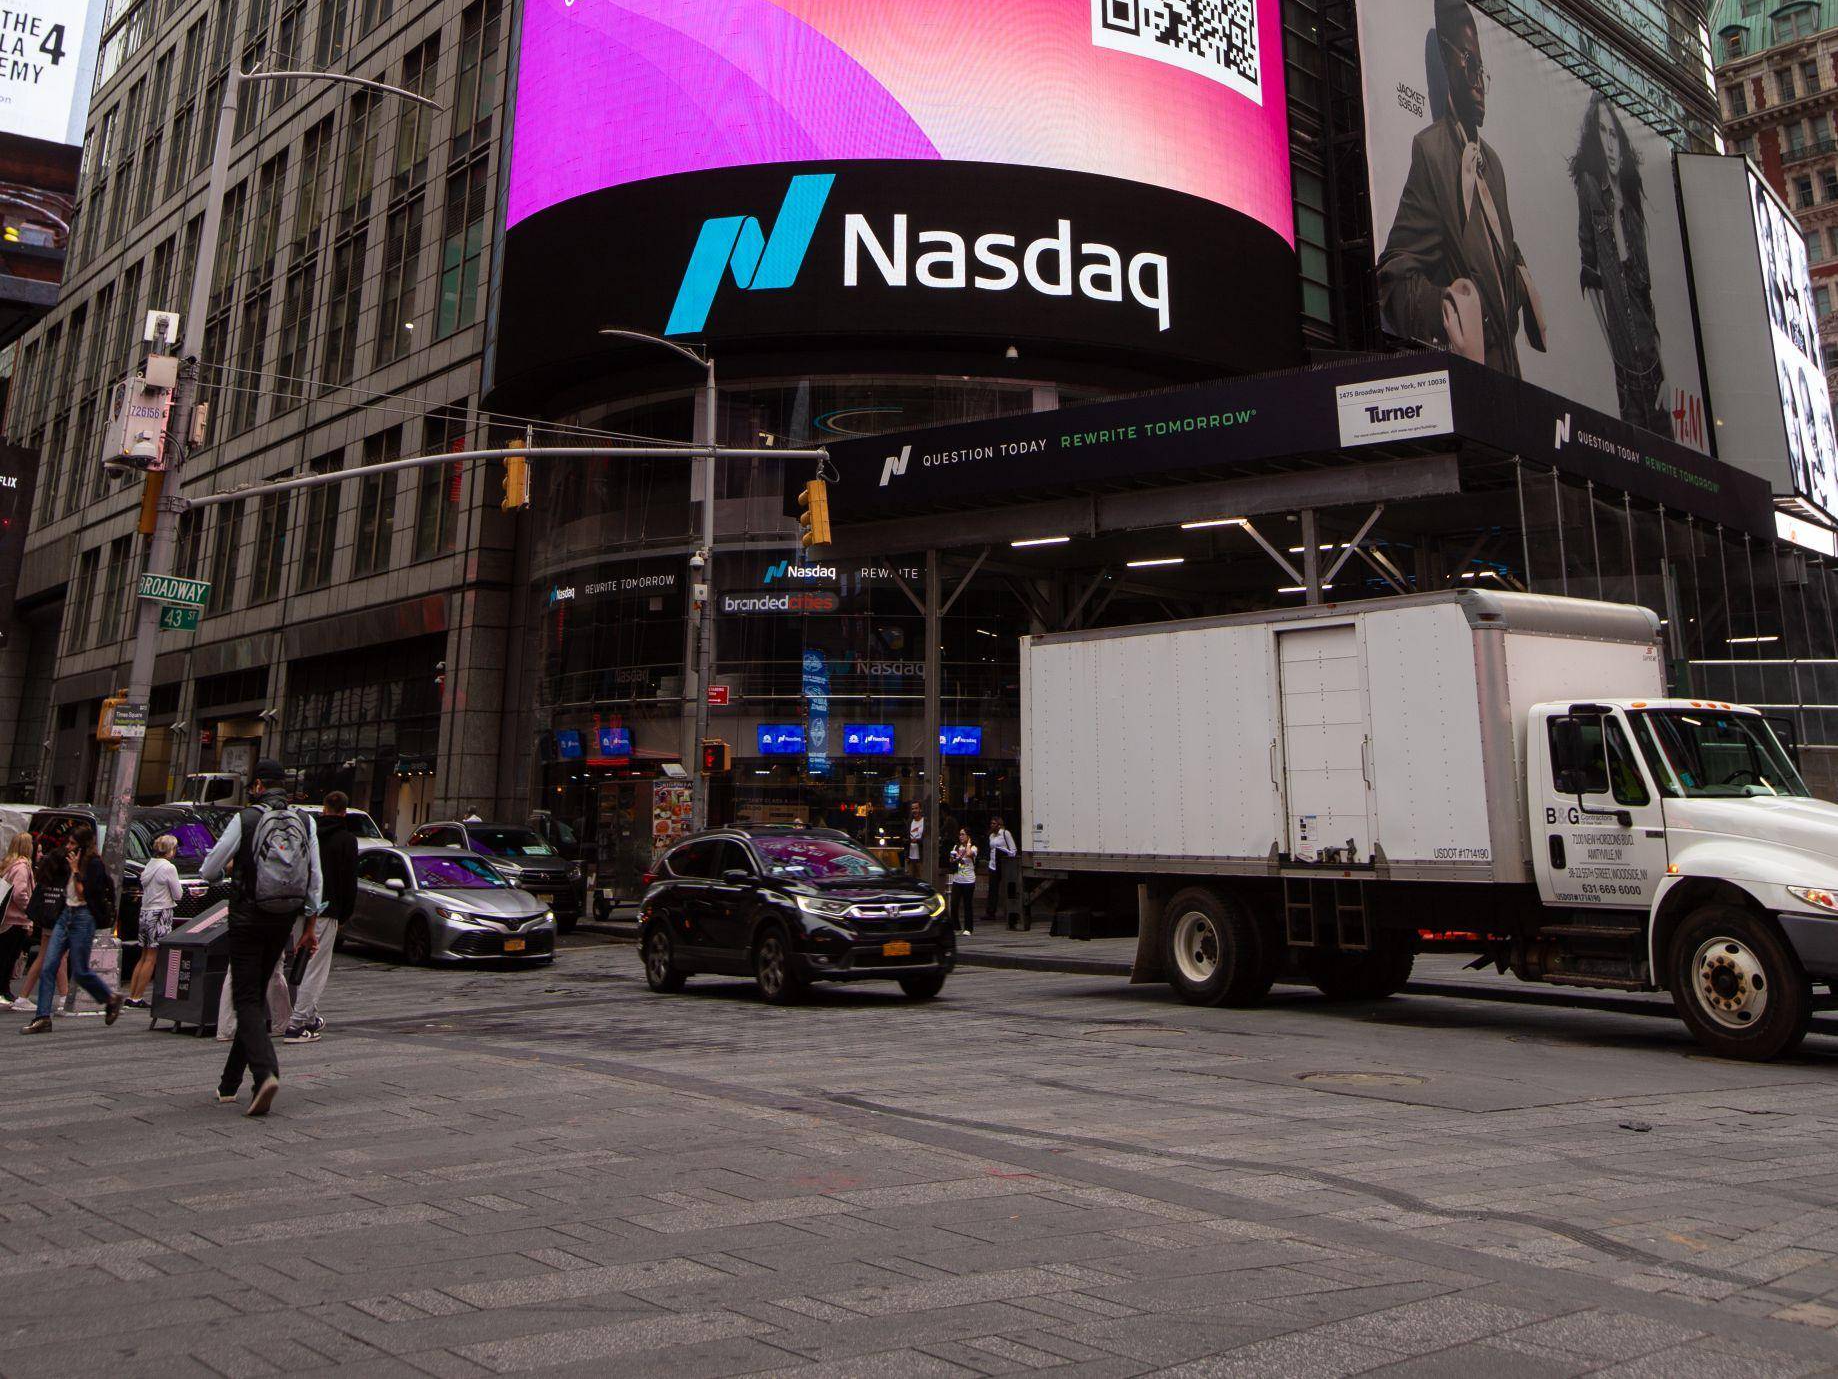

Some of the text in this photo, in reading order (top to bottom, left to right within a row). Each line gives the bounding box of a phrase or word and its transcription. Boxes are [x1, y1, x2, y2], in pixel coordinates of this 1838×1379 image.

[2, 10, 43, 38] THE
[39, 24, 66, 65] 4
[1397, 81, 1425, 106] JACKET
[1398, 95, 1422, 118] $35.99
[844, 214, 1171, 331] Nasdaq
[1339, 391, 1353, 399] 1475
[1355, 386, 1385, 397] Broadway
[1386, 385, 1399, 393] New
[1400, 383, 1416, 391] York,
[1428, 377, 1447, 386] 10036
[1365, 404, 1423, 423] Turner
[1672, 387, 1704, 452] H&M
[923, 447, 993, 467] QUESTION
[1000, 439, 1047, 456] TODAY
[1061, 427, 1137, 448] REWRITE
[1577, 430, 1615, 455] QUESTION
[1617, 446, 1640, 464] TODAY
[1644, 455, 1678, 478] REWRITE
[788, 565, 918, 580] Nasdaq REWTE
[139, 576, 206, 602] BROADWAY
[556, 574, 675, 600] Nasdaq REWRITE TOMORROW
[165, 609, 198, 627] 43 ST
[1546, 807, 1580, 824] B&G
[1596, 834, 1621, 845] HORIZONS
[1434, 848, 1489, 859] USDOT #1714190
[1582, 883, 1597, 894] 631
